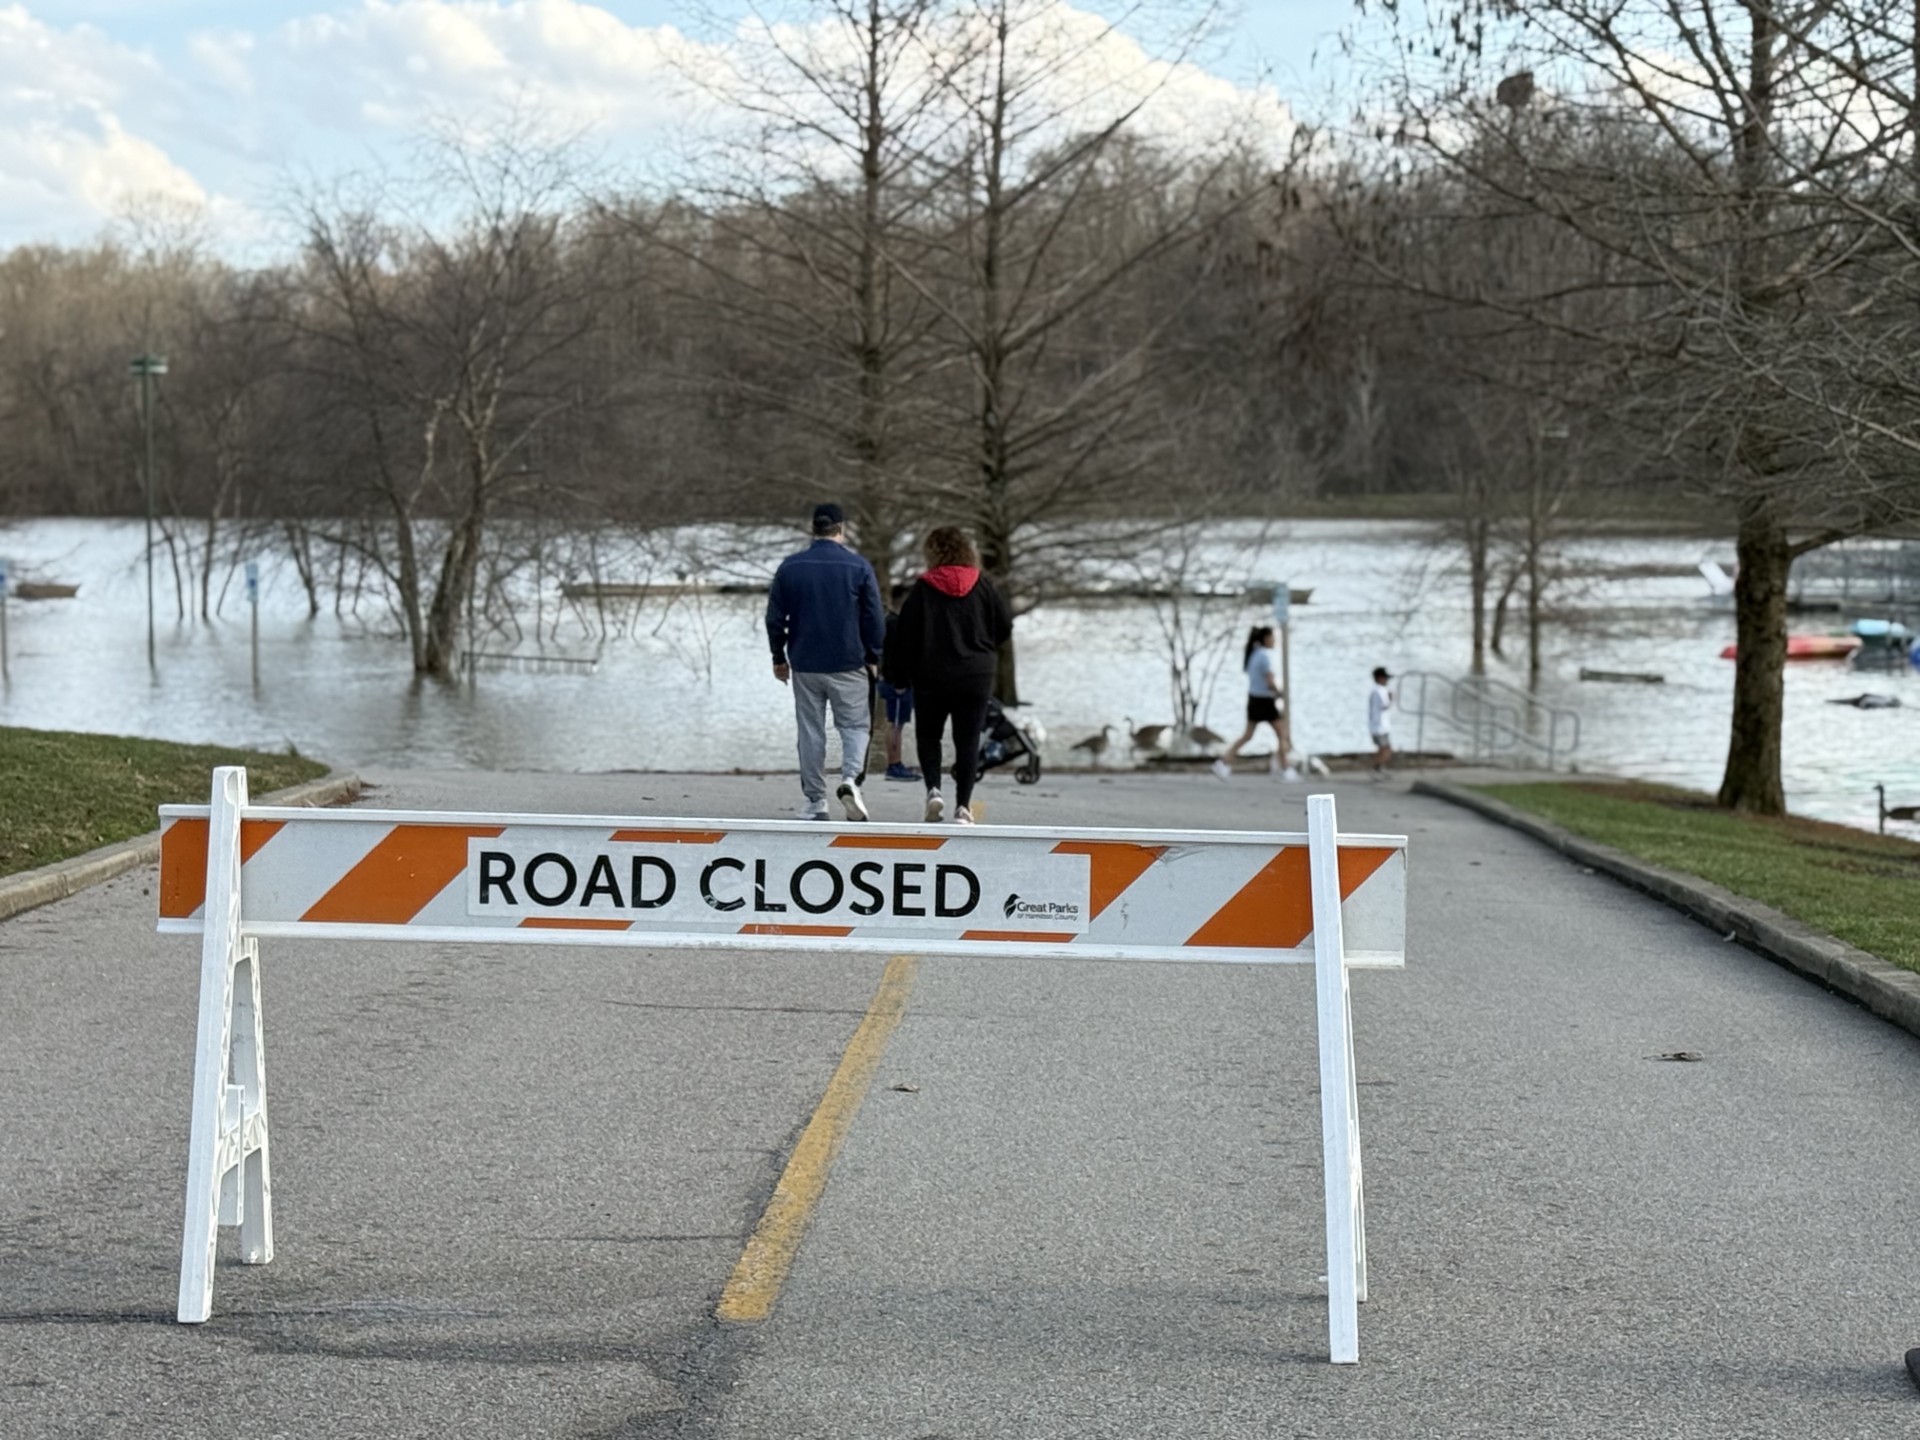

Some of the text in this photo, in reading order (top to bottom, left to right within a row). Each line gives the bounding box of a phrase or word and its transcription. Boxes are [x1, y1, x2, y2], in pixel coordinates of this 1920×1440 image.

[479, 851, 981, 918] ROAD CLOSED
[1017, 902, 1079, 913] Great Parks
